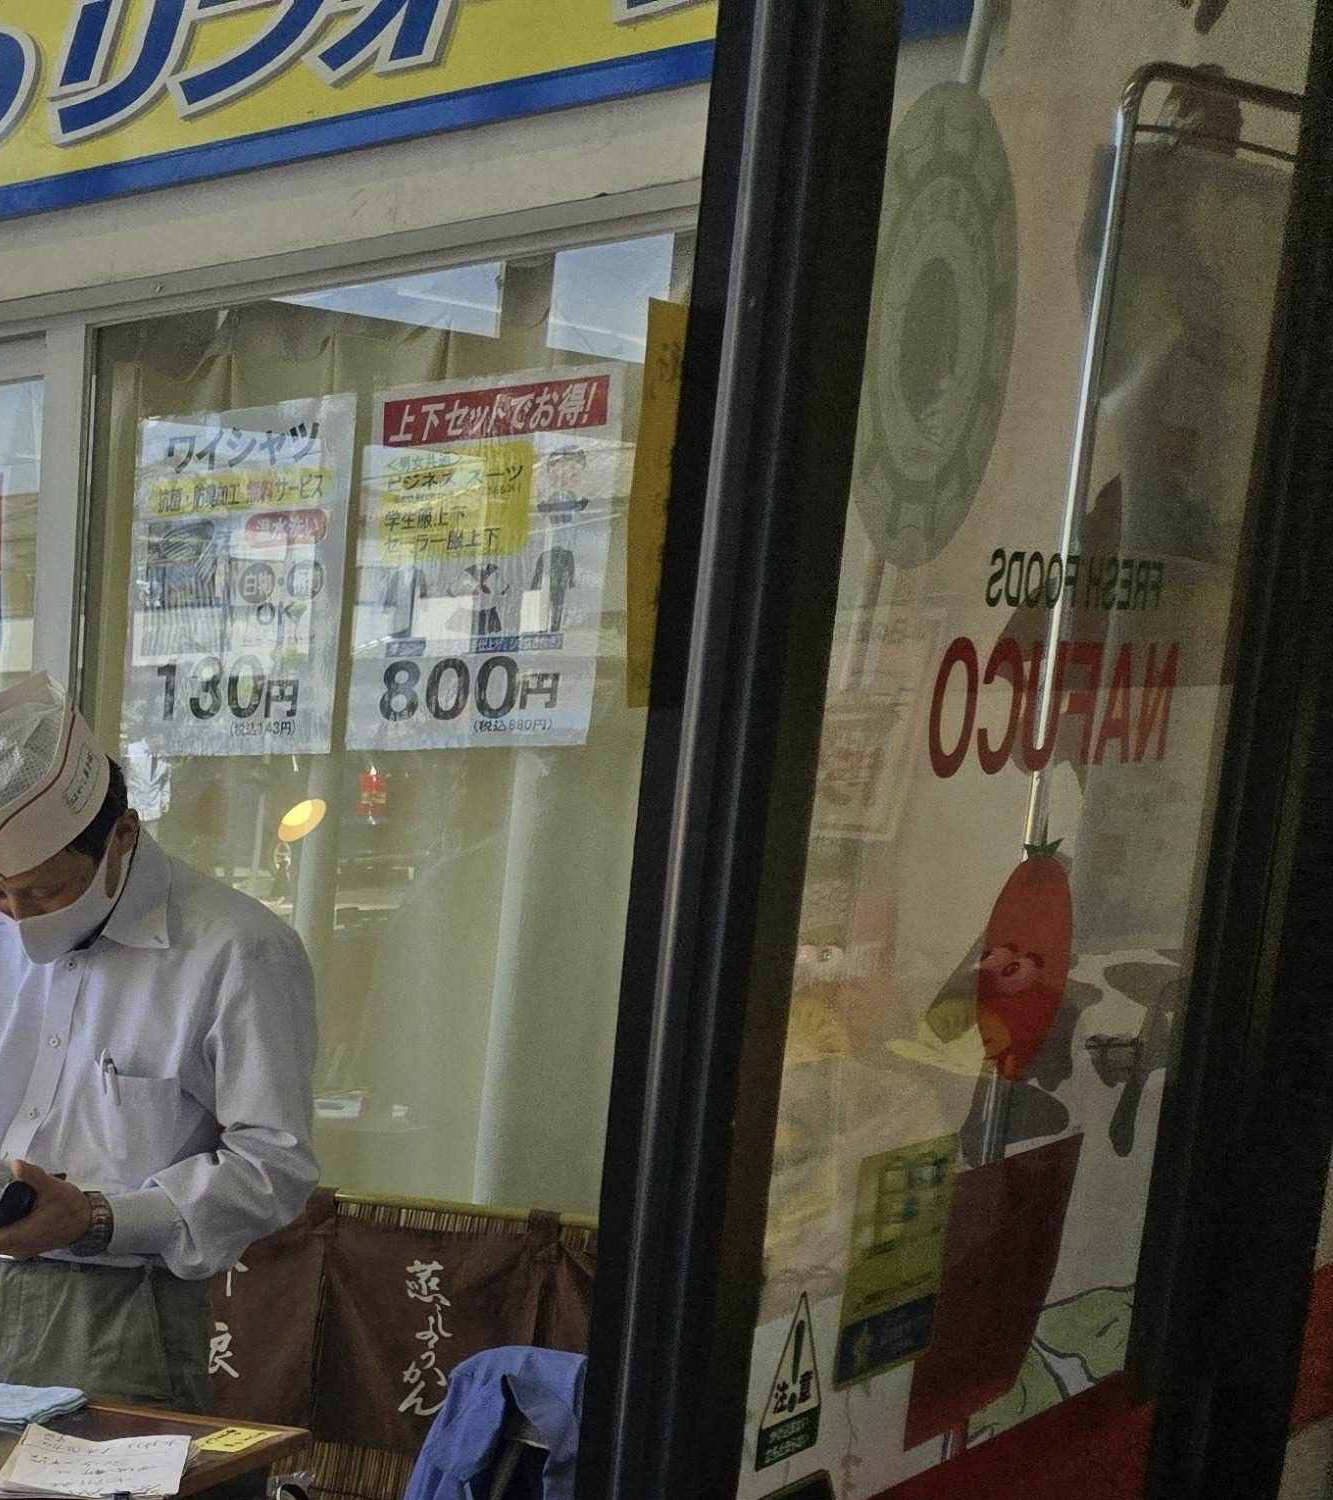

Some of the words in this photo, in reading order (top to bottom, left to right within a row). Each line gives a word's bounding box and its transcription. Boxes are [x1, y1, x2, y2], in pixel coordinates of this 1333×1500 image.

[167, 422, 320, 474] ワイシャツ
[379, 655, 560, 721] 800円
[773, 1370, 814, 1415] 注意
